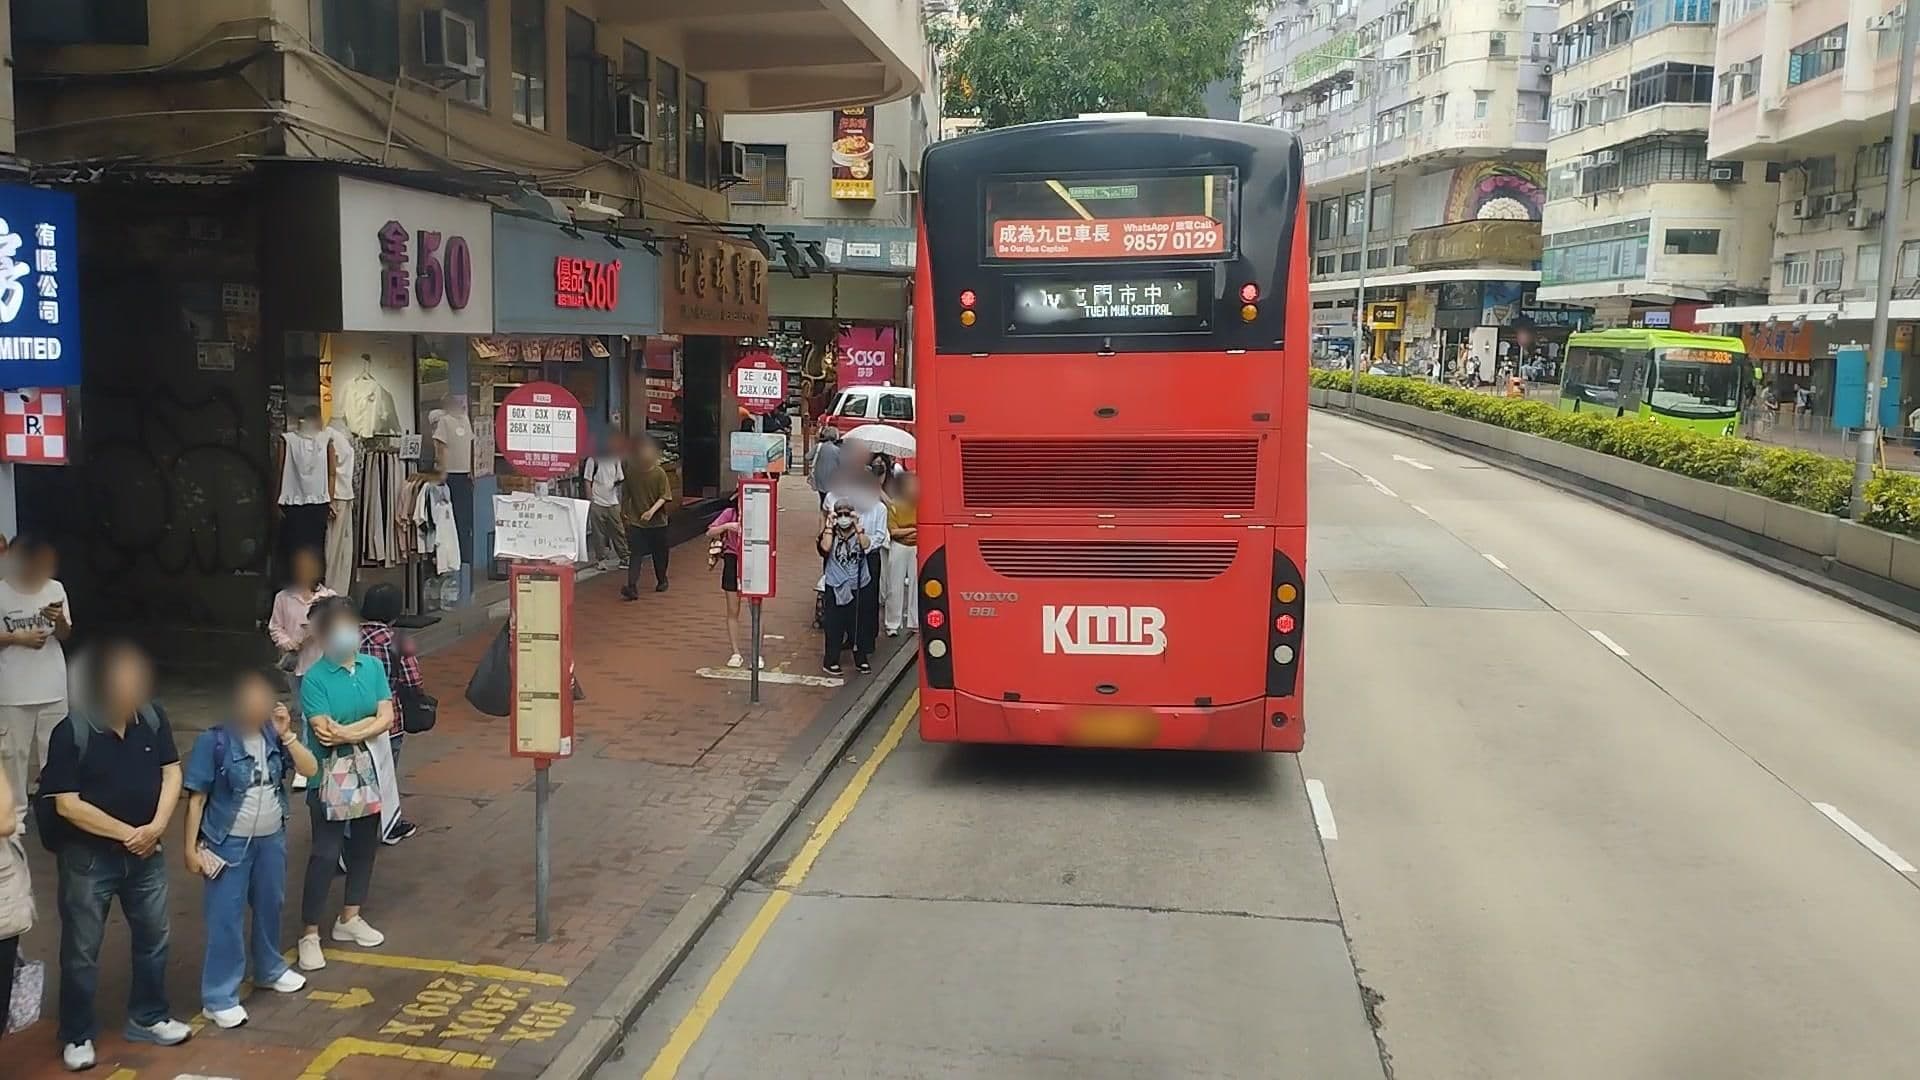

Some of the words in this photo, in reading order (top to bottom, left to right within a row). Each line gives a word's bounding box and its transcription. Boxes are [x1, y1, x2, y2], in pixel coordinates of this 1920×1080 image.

[999, 224, 1111, 244] 成為九巴車長
[1123, 223, 1169, 233] WhatsApp
[1123, 233, 1168, 252] 9857
[1172, 231, 1217, 250] 0129
[378, 220, 410, 308] 全店
[415, 230, 471, 310] 50
[36, 224, 58, 324] 有限公司
[1084, 306, 1108, 317] TUEN
[1110, 305, 1130, 316] MUN
[1131, 304, 1172, 316] CENTRAL
[846, 348, 886, 366] Sasa
[744, 371, 753, 381] 2E
[763, 373, 778, 382] 42A
[740, 385, 758, 395] 238X
[512, 408, 526, 418] 60X
[535, 409, 549, 420] 63X
[558, 410, 572, 421] 69X
[510, 423, 528, 433] 268X
[533, 424, 551, 434] 269X
[960, 592, 1018, 601] VOLVO
[1043, 605, 1168, 656] KMB
